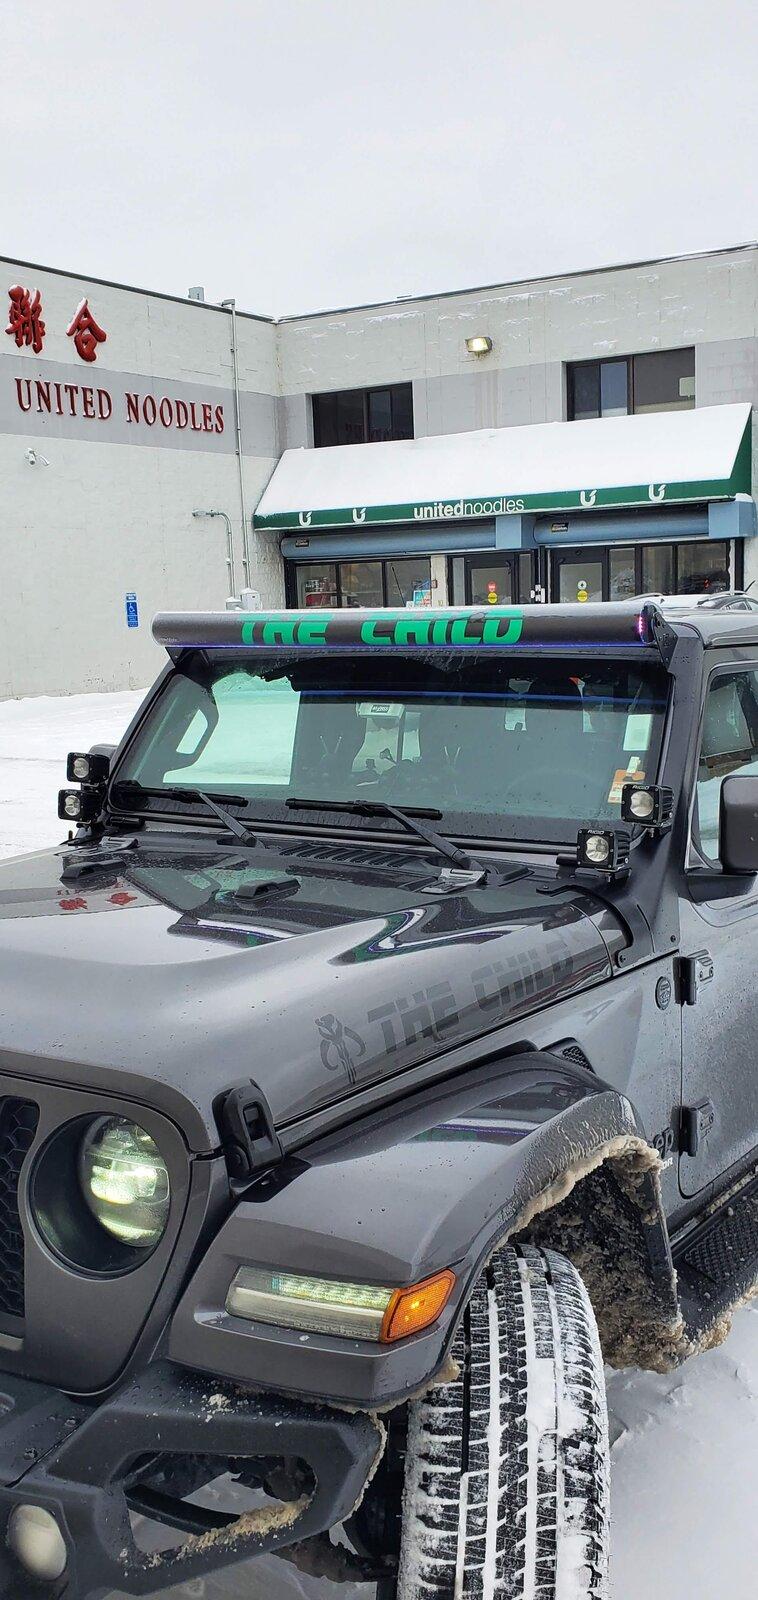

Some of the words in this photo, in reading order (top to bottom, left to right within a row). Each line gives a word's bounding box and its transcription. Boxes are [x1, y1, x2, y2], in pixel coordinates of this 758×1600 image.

[15, 377, 112, 420] UNITED
[125, 392, 225, 433] NOODLES
[239, 613, 334, 645] THE
[359, 609, 524, 645] CHILD
[367, 981, 459, 1054] THE
[470, 939, 574, 1012] CHILD
